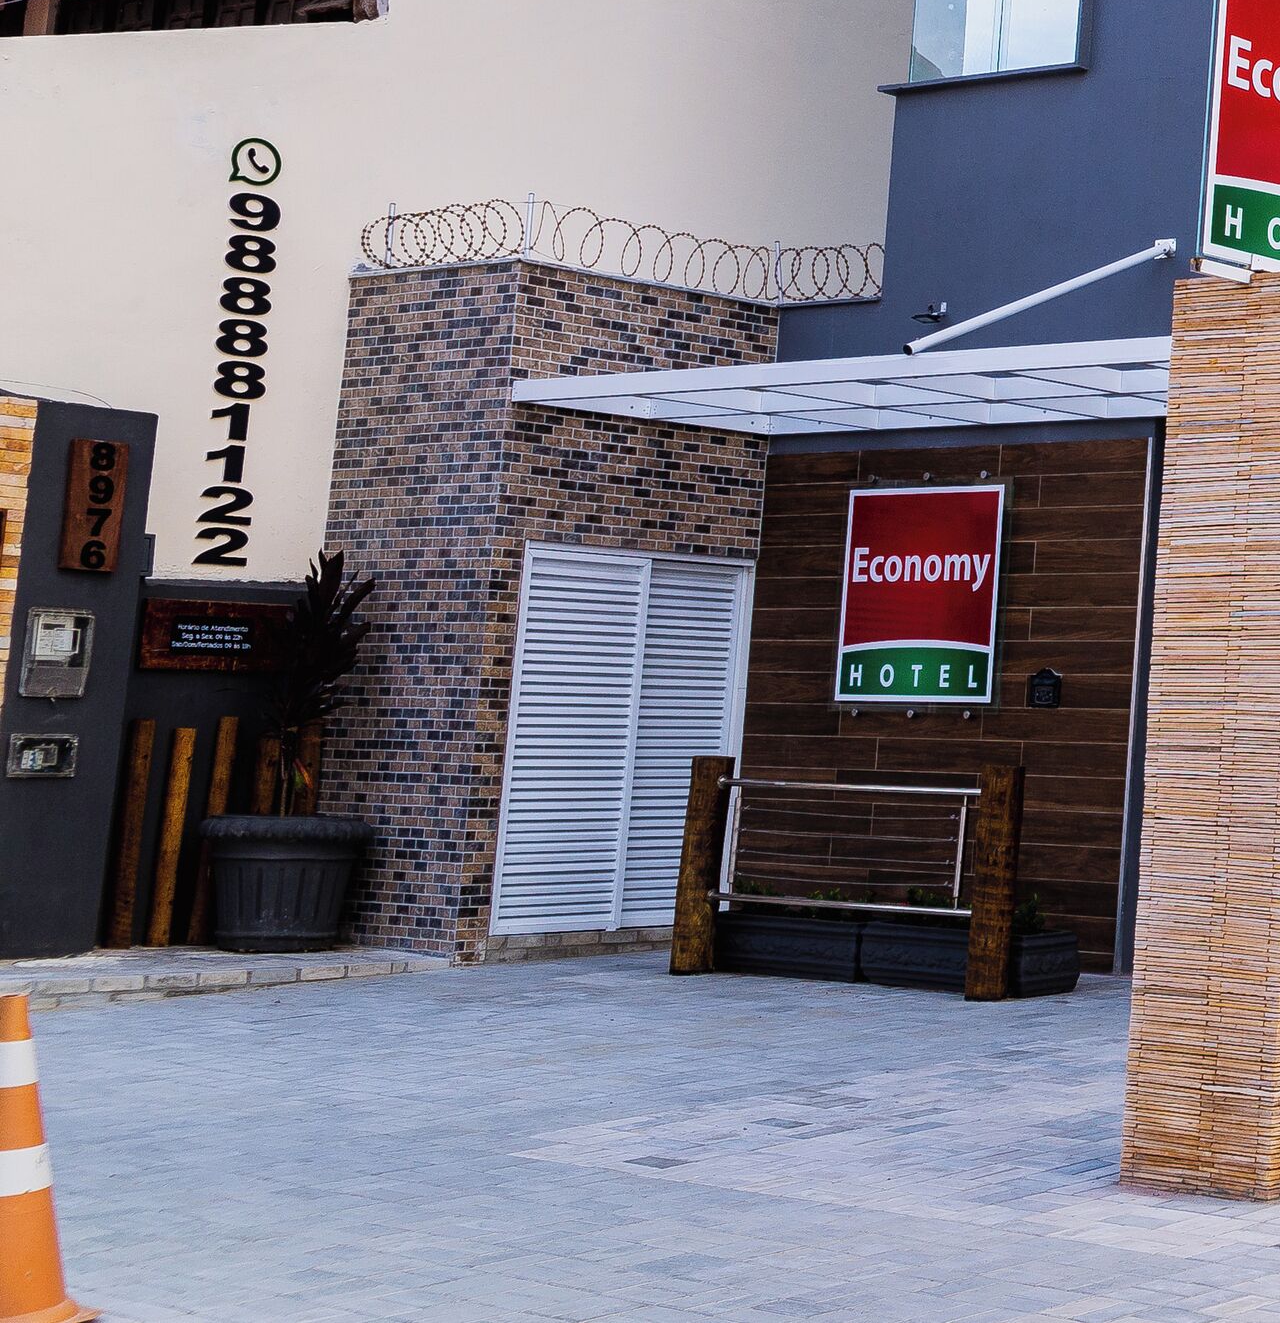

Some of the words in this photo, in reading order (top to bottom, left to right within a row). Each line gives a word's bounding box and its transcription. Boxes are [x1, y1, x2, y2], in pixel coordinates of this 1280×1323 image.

[191, 192, 281, 567] 988881122
[80, 442, 116, 569] 8976
[852, 547, 991, 592] Economy
[210, 625, 249, 633] Atendimento
[849, 663, 978, 688] HOTEL
